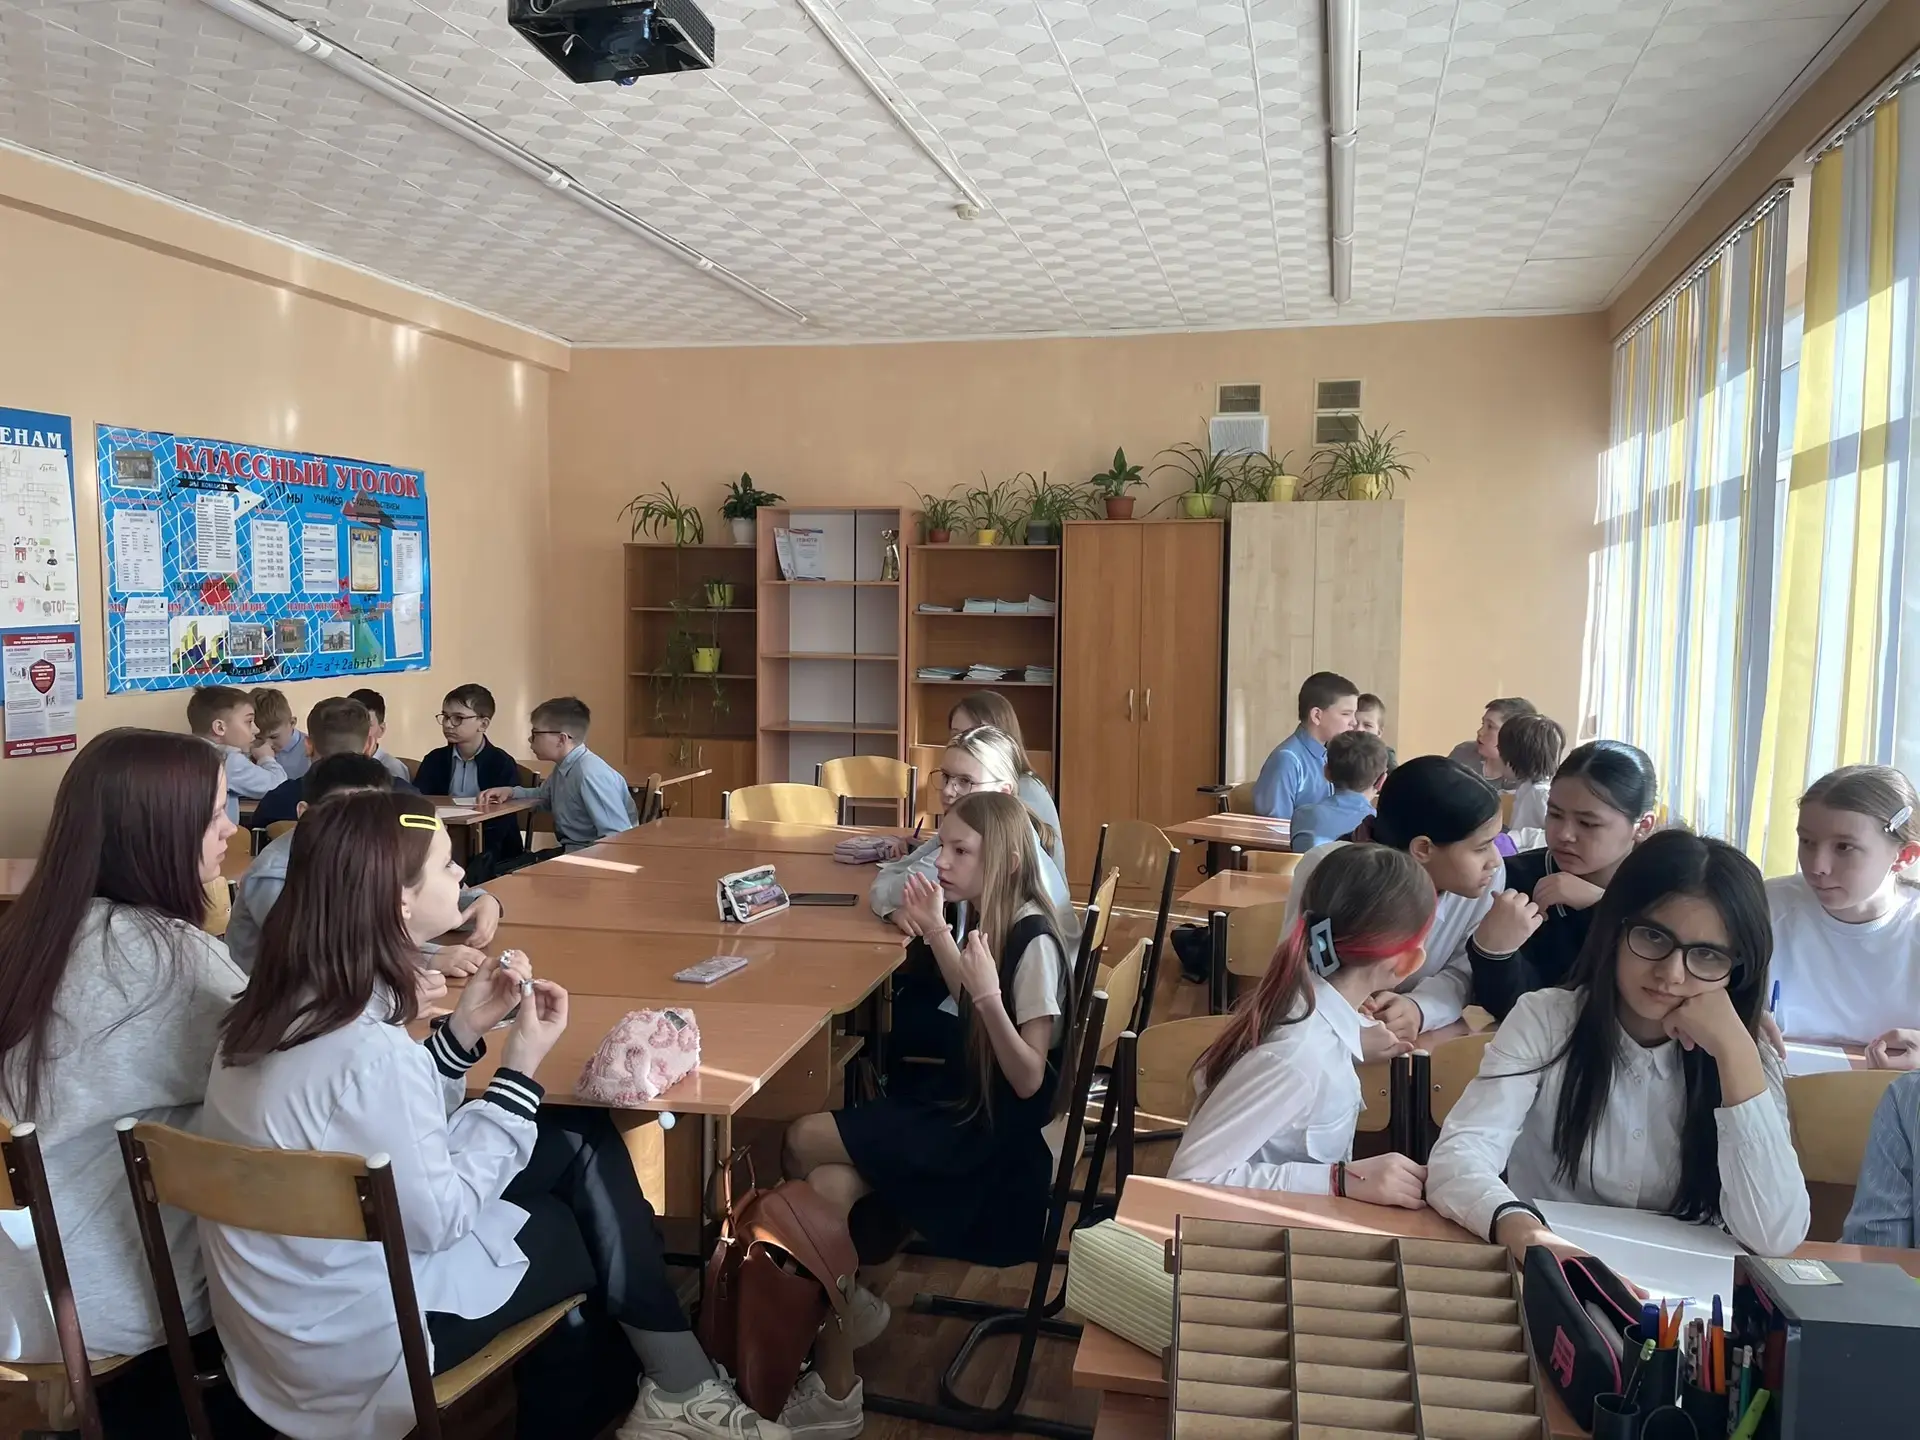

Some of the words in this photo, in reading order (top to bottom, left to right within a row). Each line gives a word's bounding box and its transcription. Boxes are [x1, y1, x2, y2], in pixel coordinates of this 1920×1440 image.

[175, 442, 328, 488] КЛАССНЫЙ
[333, 464, 420, 498] УГОЛОК
[287, 493, 303, 504] МЫ
